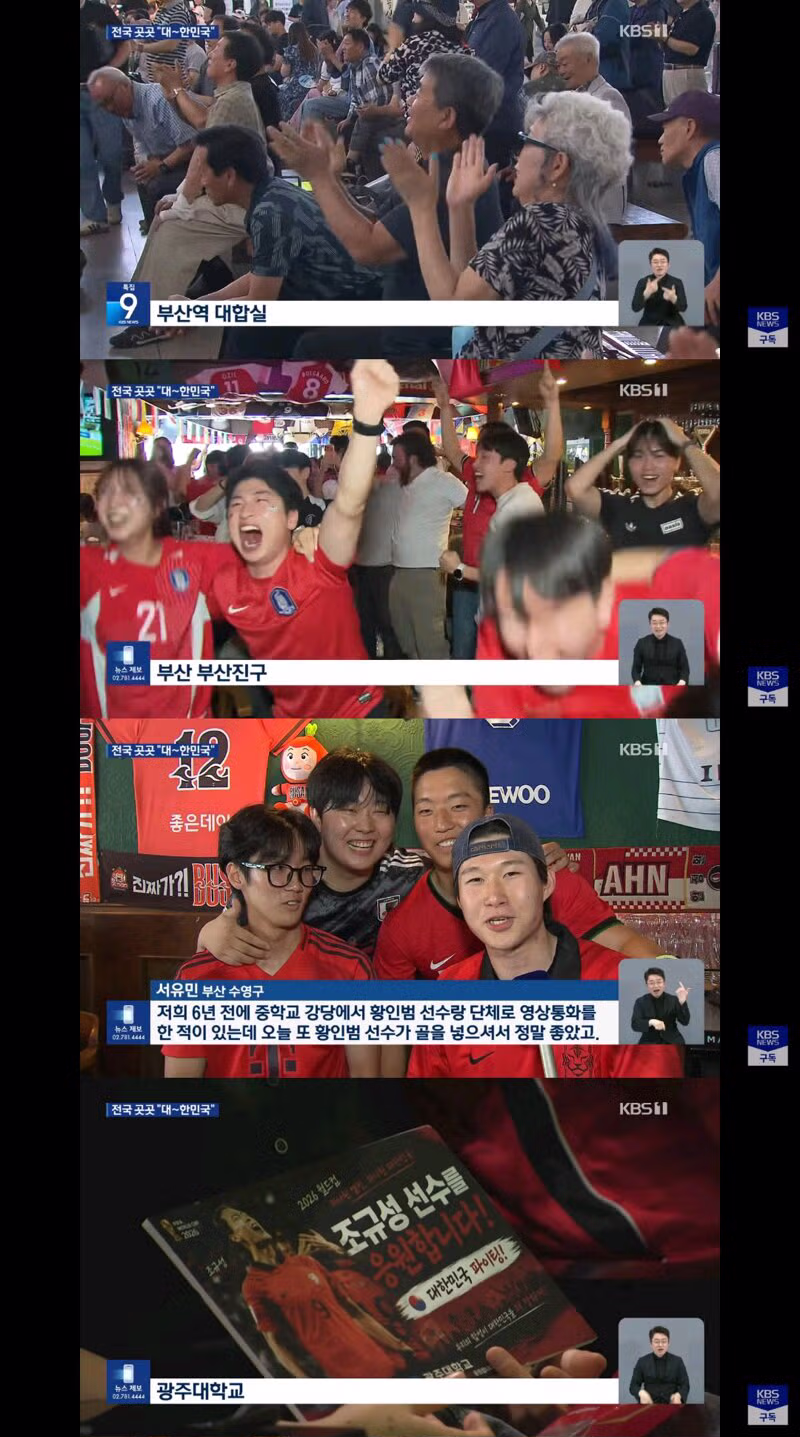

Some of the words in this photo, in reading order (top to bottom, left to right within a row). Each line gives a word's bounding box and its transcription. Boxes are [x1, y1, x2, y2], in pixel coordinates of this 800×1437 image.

[302, 378, 321, 400] 8
[136, 599, 168, 642] 21
[170, 728, 231, 790] 12
[488, 784, 551, 805] EWOO
[602, 864, 668, 897] AHN
[330, 1193, 410, 1257] 조규성
[402, 1166, 470, 1219] 선수를
[370, 1193, 495, 1288] 응원합니다!
[425, 1265, 471, 1302] 대한민국
[469, 1244, 509, 1275] 파이팅!
